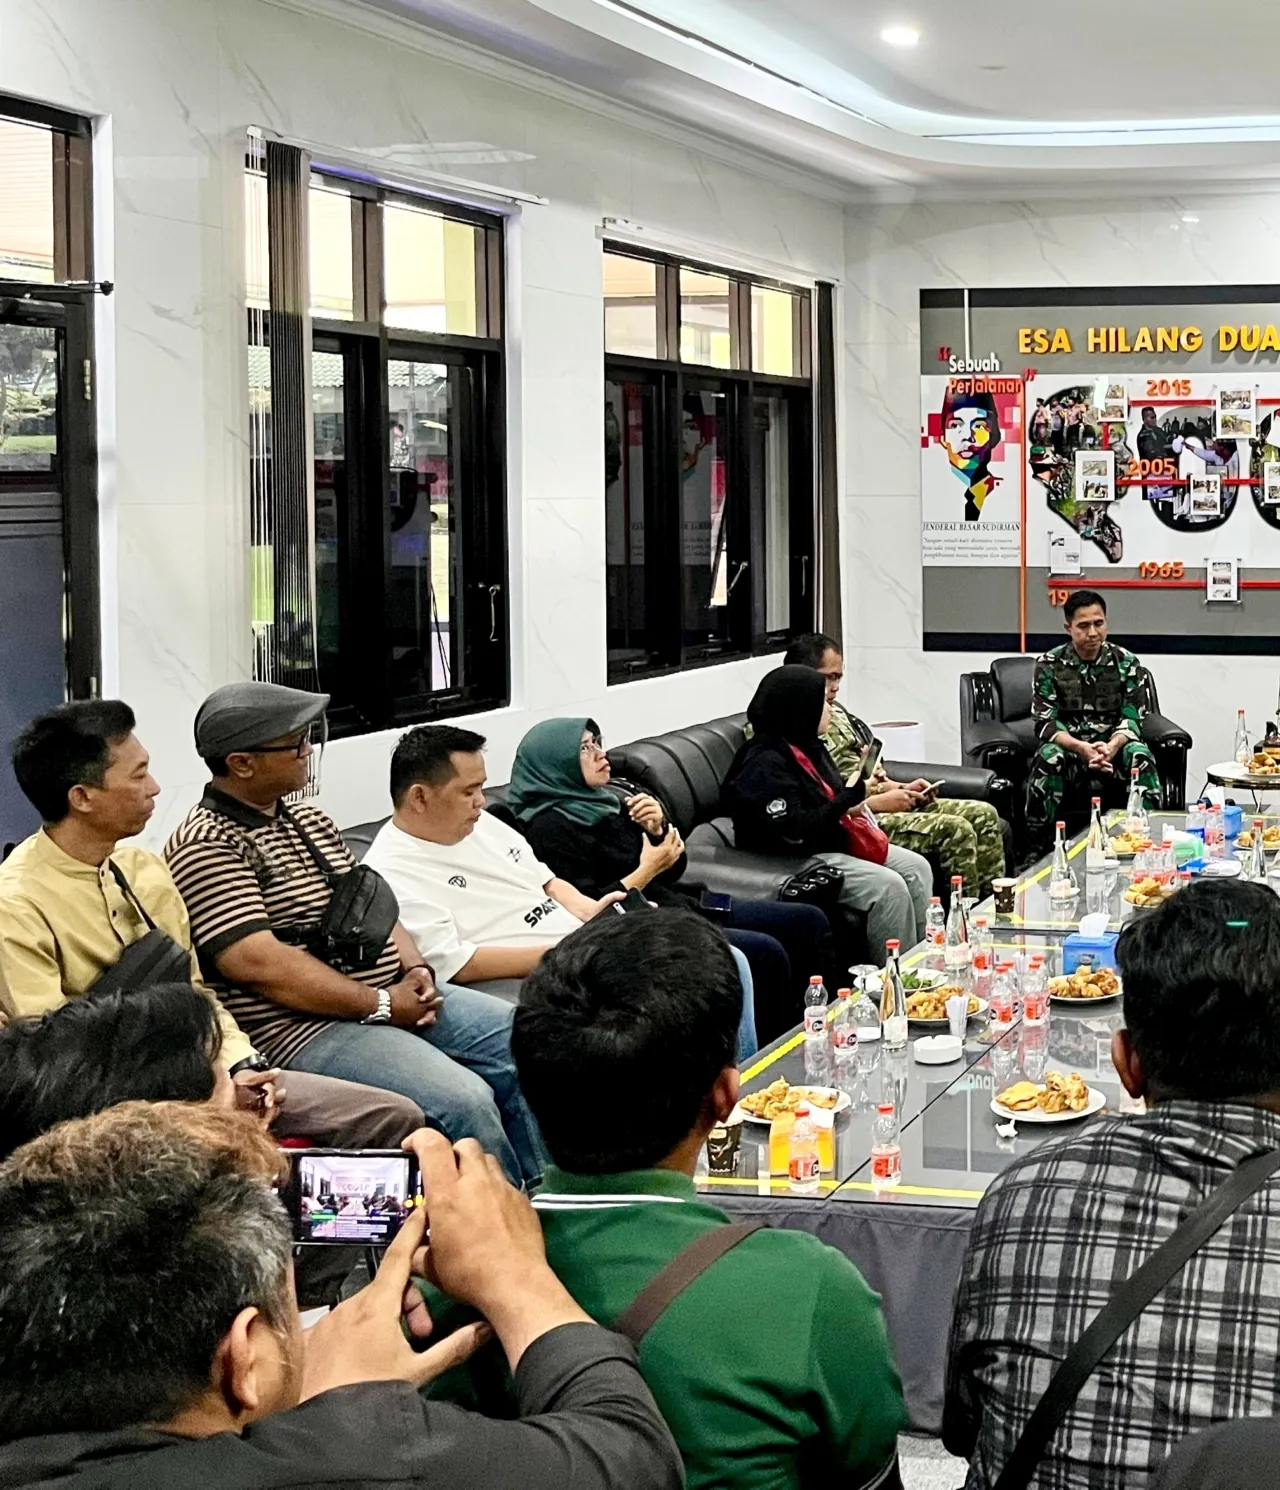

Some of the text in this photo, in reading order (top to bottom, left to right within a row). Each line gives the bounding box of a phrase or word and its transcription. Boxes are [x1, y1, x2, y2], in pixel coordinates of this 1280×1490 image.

[1018, 328, 1072, 354] ESA
[1087, 326, 1204, 353] HILANG
[1146, 379, 1192, 396] 2015
[1128, 457, 1176, 476] 2005
[959, 523, 981, 532] BESAR
[1139, 561, 1185, 579] 1965
[1048, 589, 1070, 607] 19
